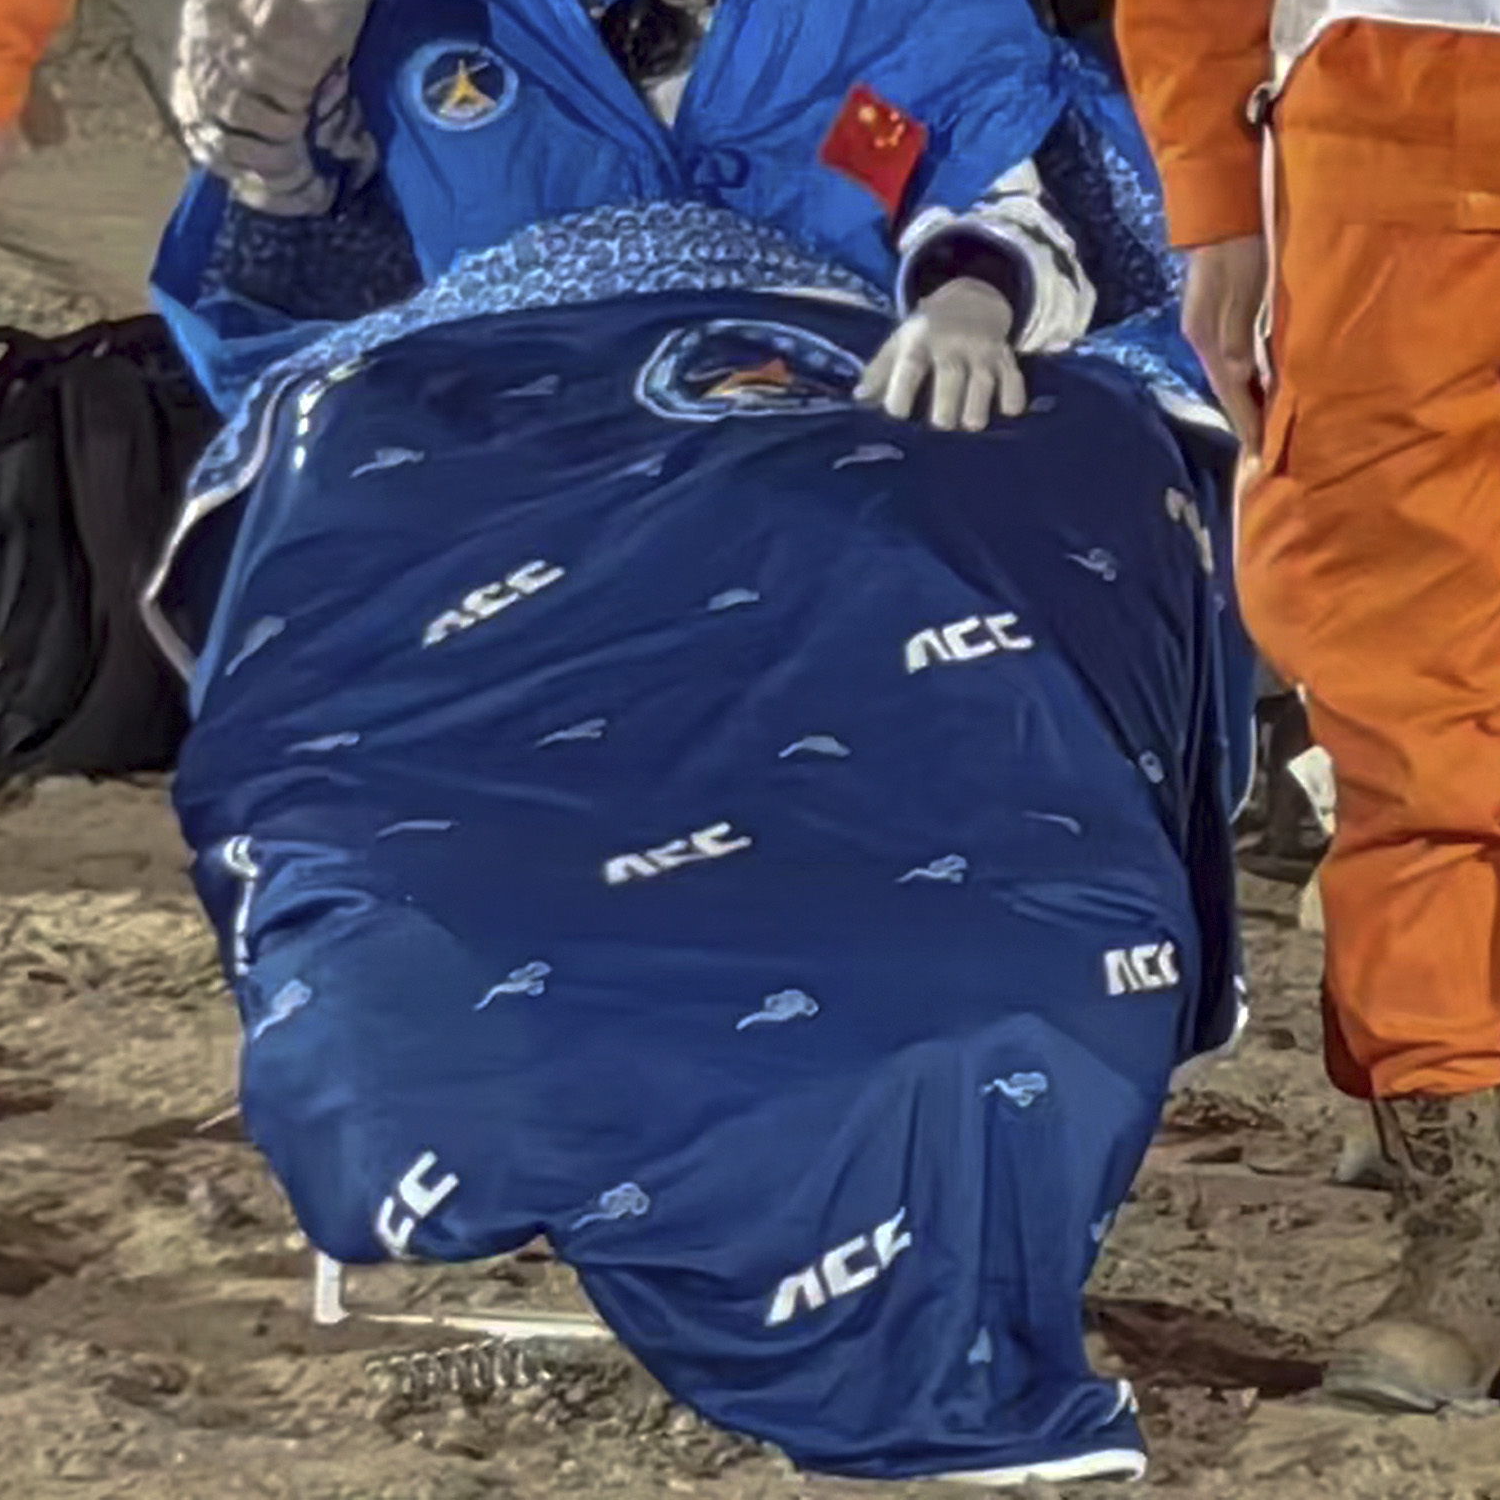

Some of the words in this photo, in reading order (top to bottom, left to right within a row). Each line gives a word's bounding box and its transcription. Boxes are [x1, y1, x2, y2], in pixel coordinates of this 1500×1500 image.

[422, 559, 566, 649] ACC
[905, 611, 1034, 674] ACC
[605, 822, 752, 885] ACC
[1105, 940, 1179, 996] ACC
[377, 1150, 459, 1256] CC
[764, 1206, 913, 1328] ACC
